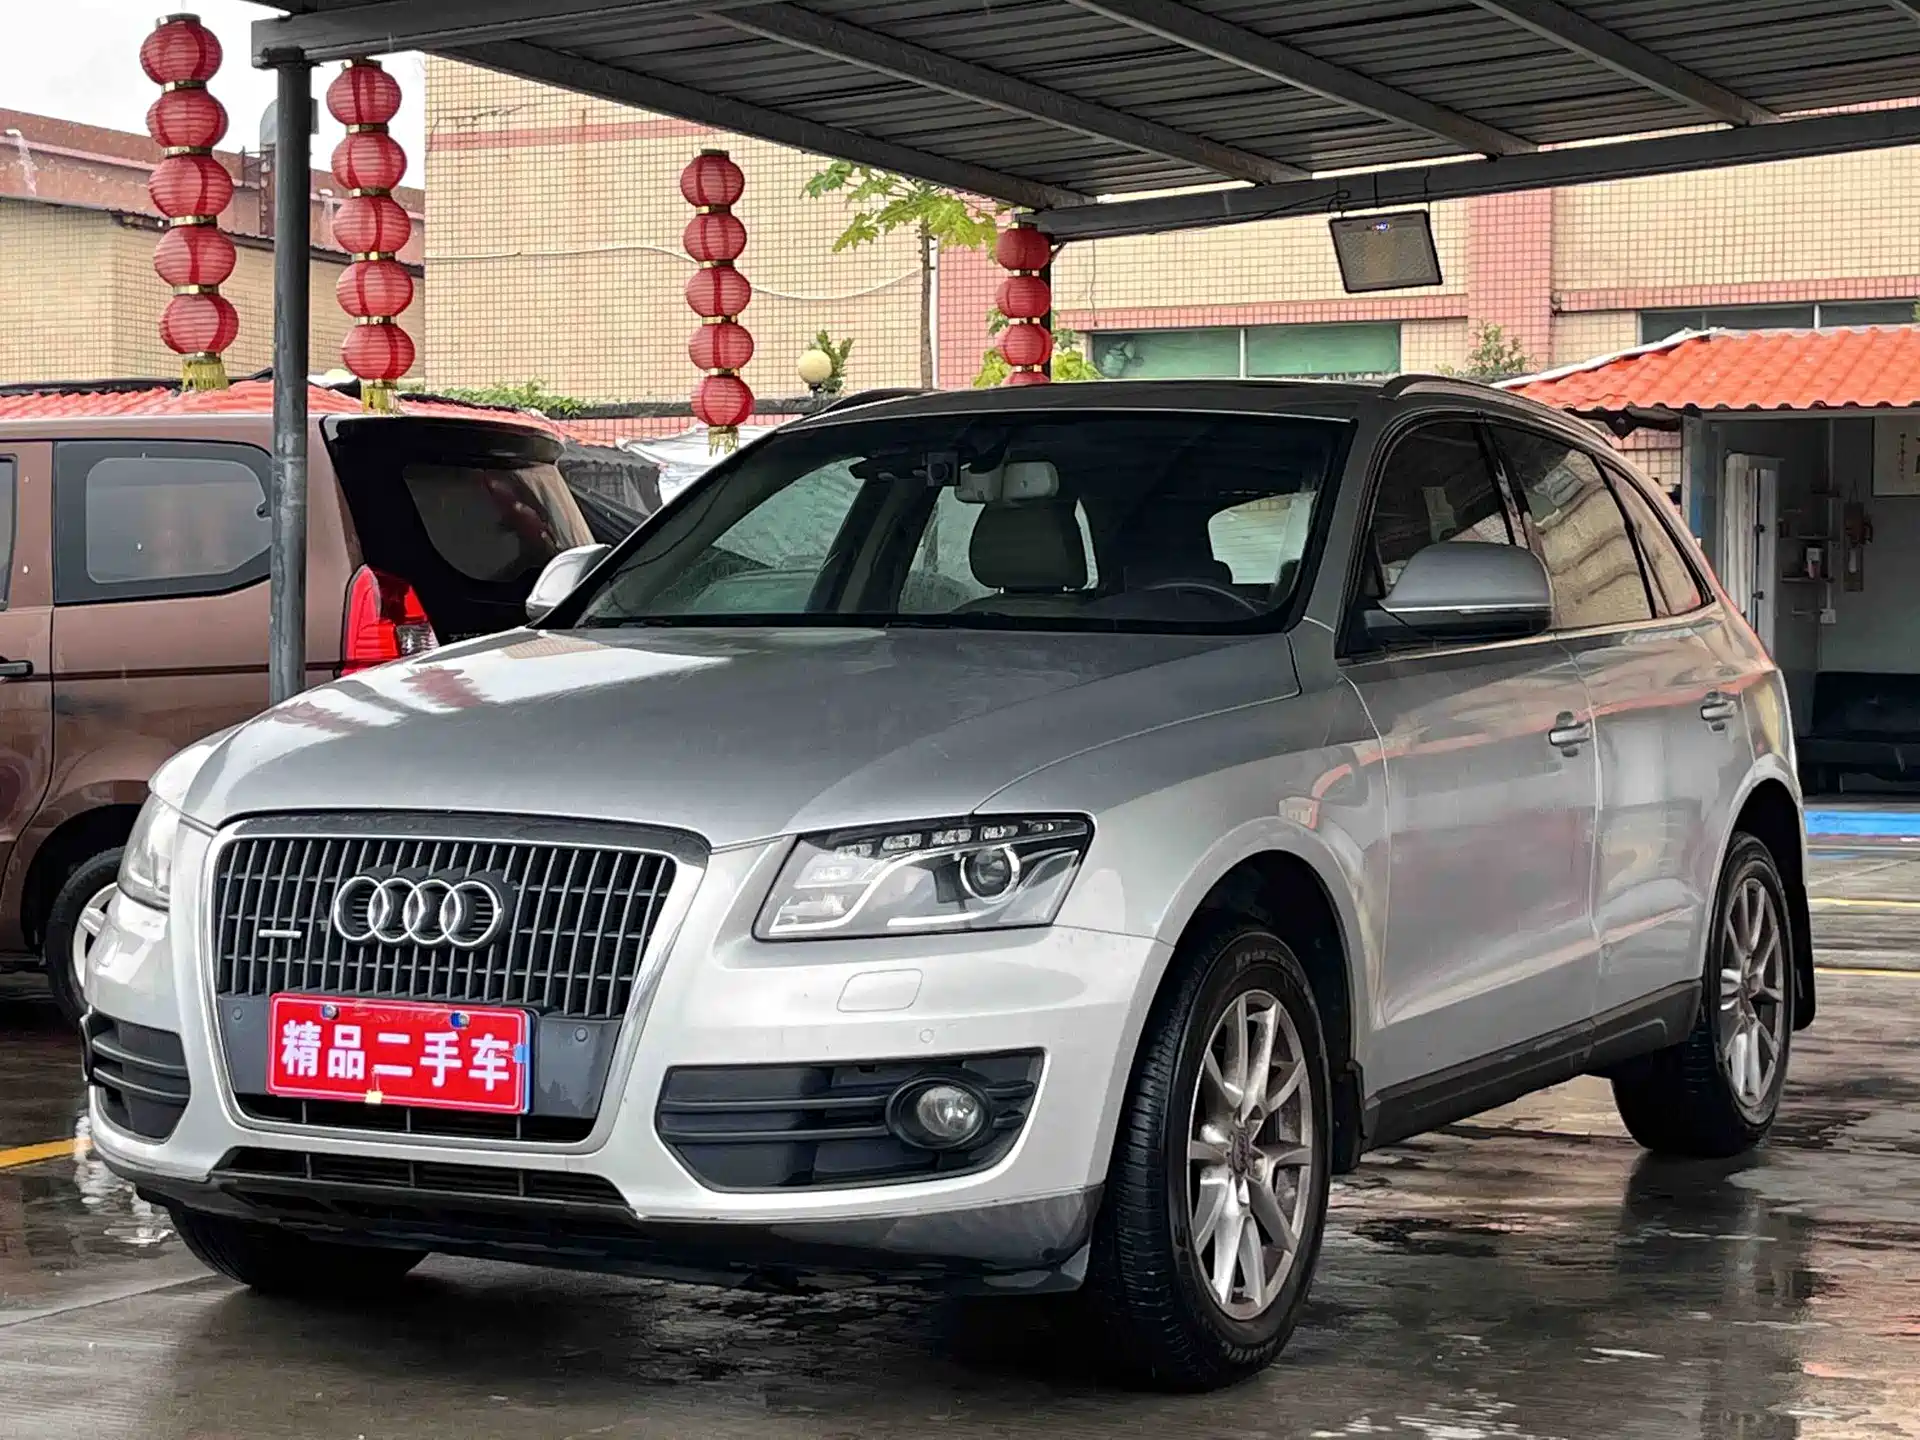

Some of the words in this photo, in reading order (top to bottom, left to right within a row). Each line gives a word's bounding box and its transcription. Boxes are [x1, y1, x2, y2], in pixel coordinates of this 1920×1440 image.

[281, 1020, 510, 1092] 精品二手车
